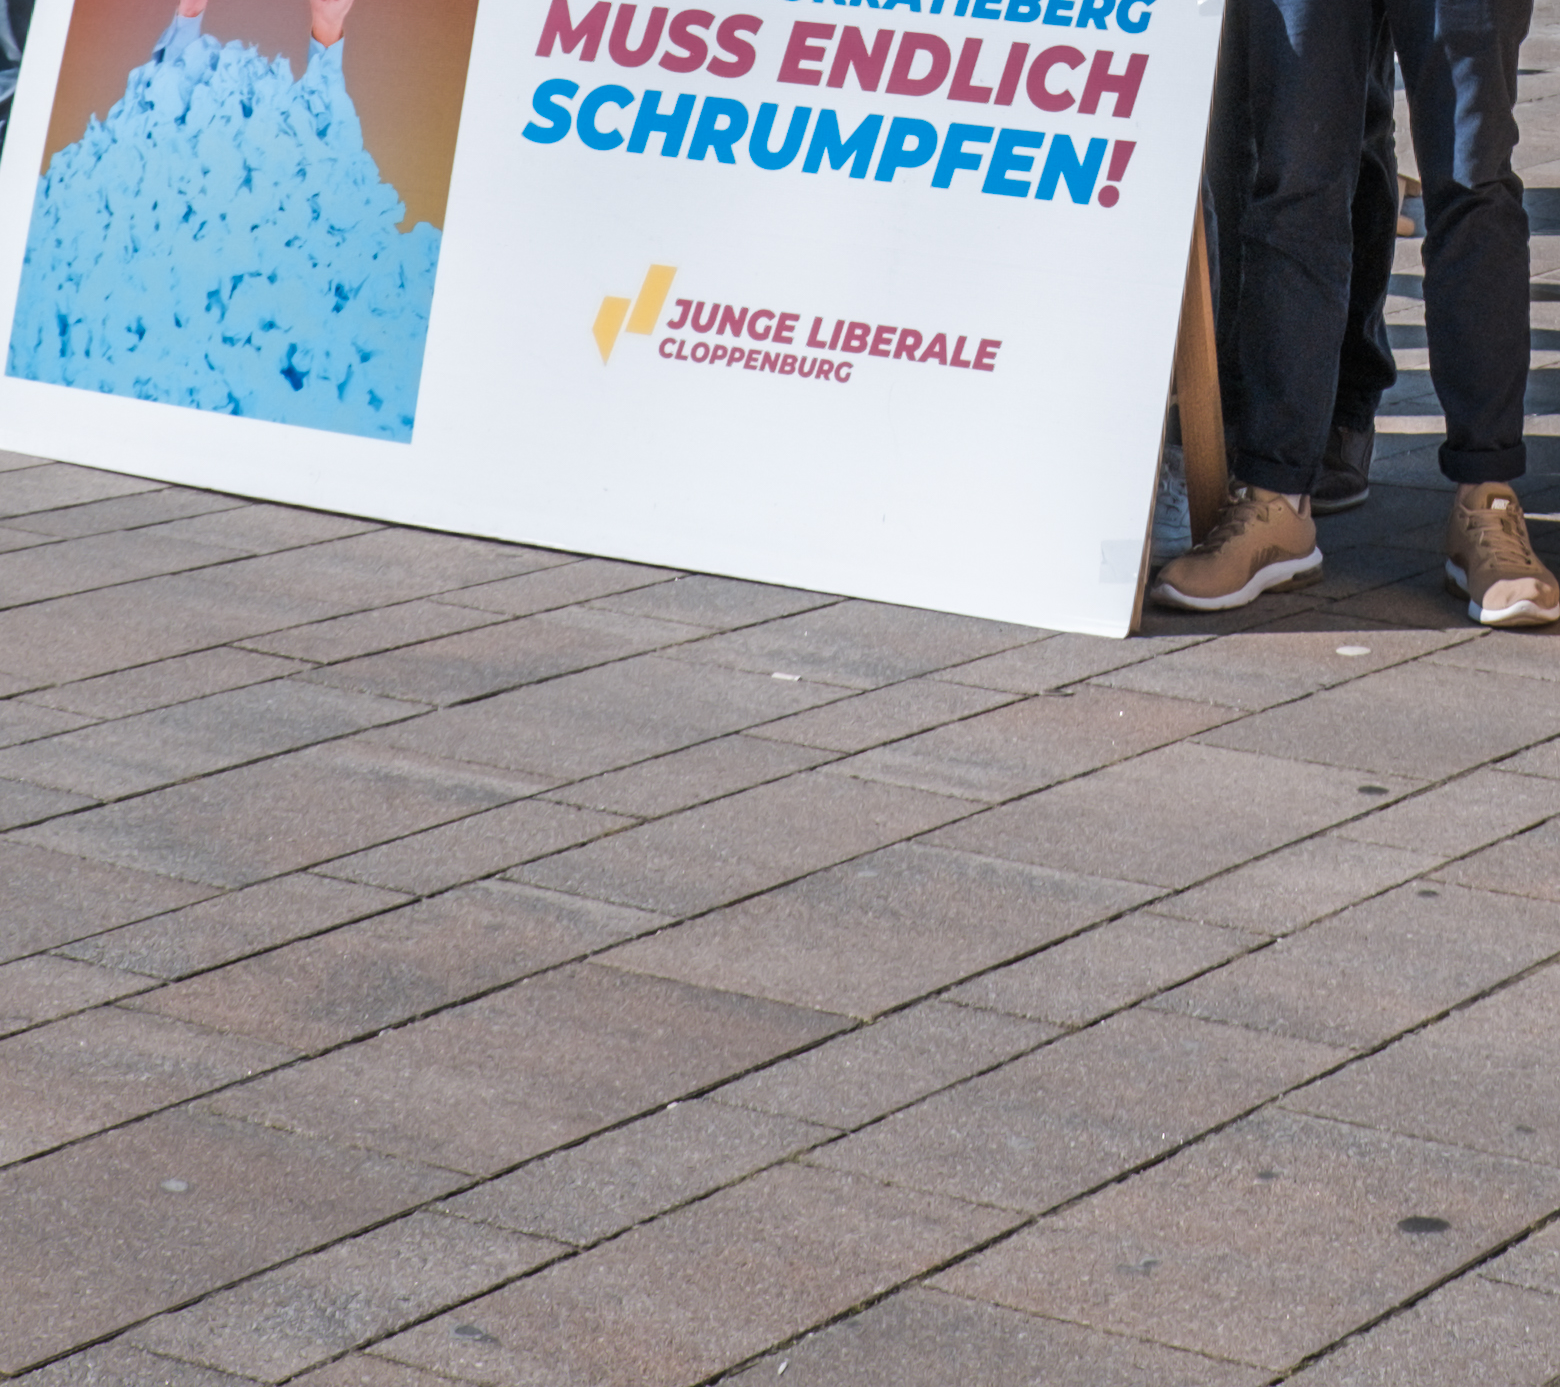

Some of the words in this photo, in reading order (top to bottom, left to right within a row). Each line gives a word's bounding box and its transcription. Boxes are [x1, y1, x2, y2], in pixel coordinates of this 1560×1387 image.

[776, 20, 1151, 120] ENDLICH
[520, 77, 1138, 210] SCHRUMPFEN!
[657, 337, 855, 385] CLOPPENBURG
[667, 297, 801, 347] JUNGE
[806, 316, 1004, 374] LIBERALE
